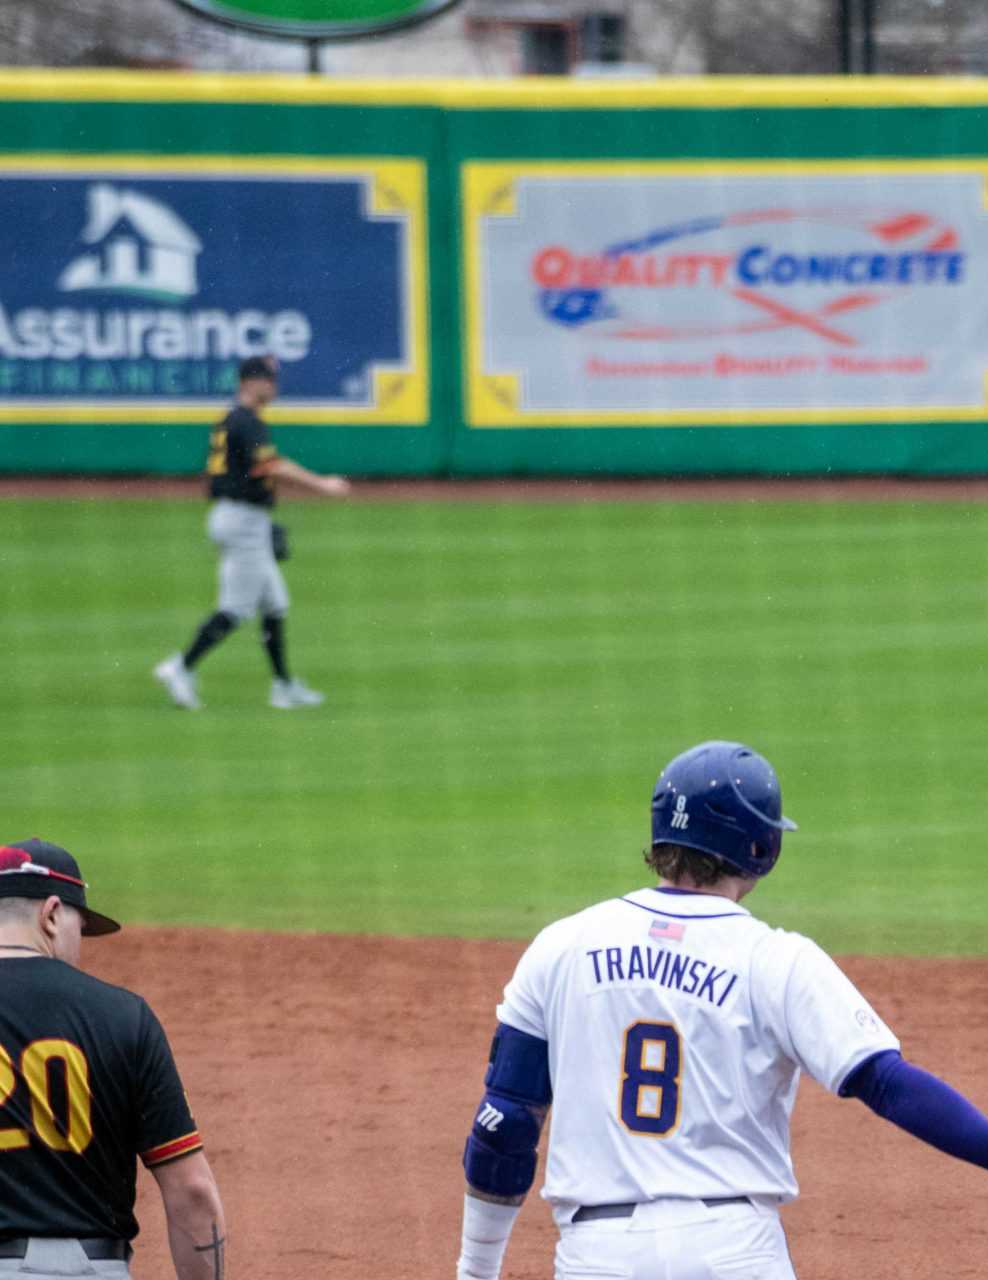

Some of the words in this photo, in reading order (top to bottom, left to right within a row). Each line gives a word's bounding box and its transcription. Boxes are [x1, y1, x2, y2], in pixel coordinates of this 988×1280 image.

[532, 245, 730, 288] QUALITY
[736, 243, 964, 286] CONCRETE
[0, 358, 238, 393] FINANCIA
[586, 945, 739, 1007] TRAVINSKI
[619, 1019, 683, 1138] 8
